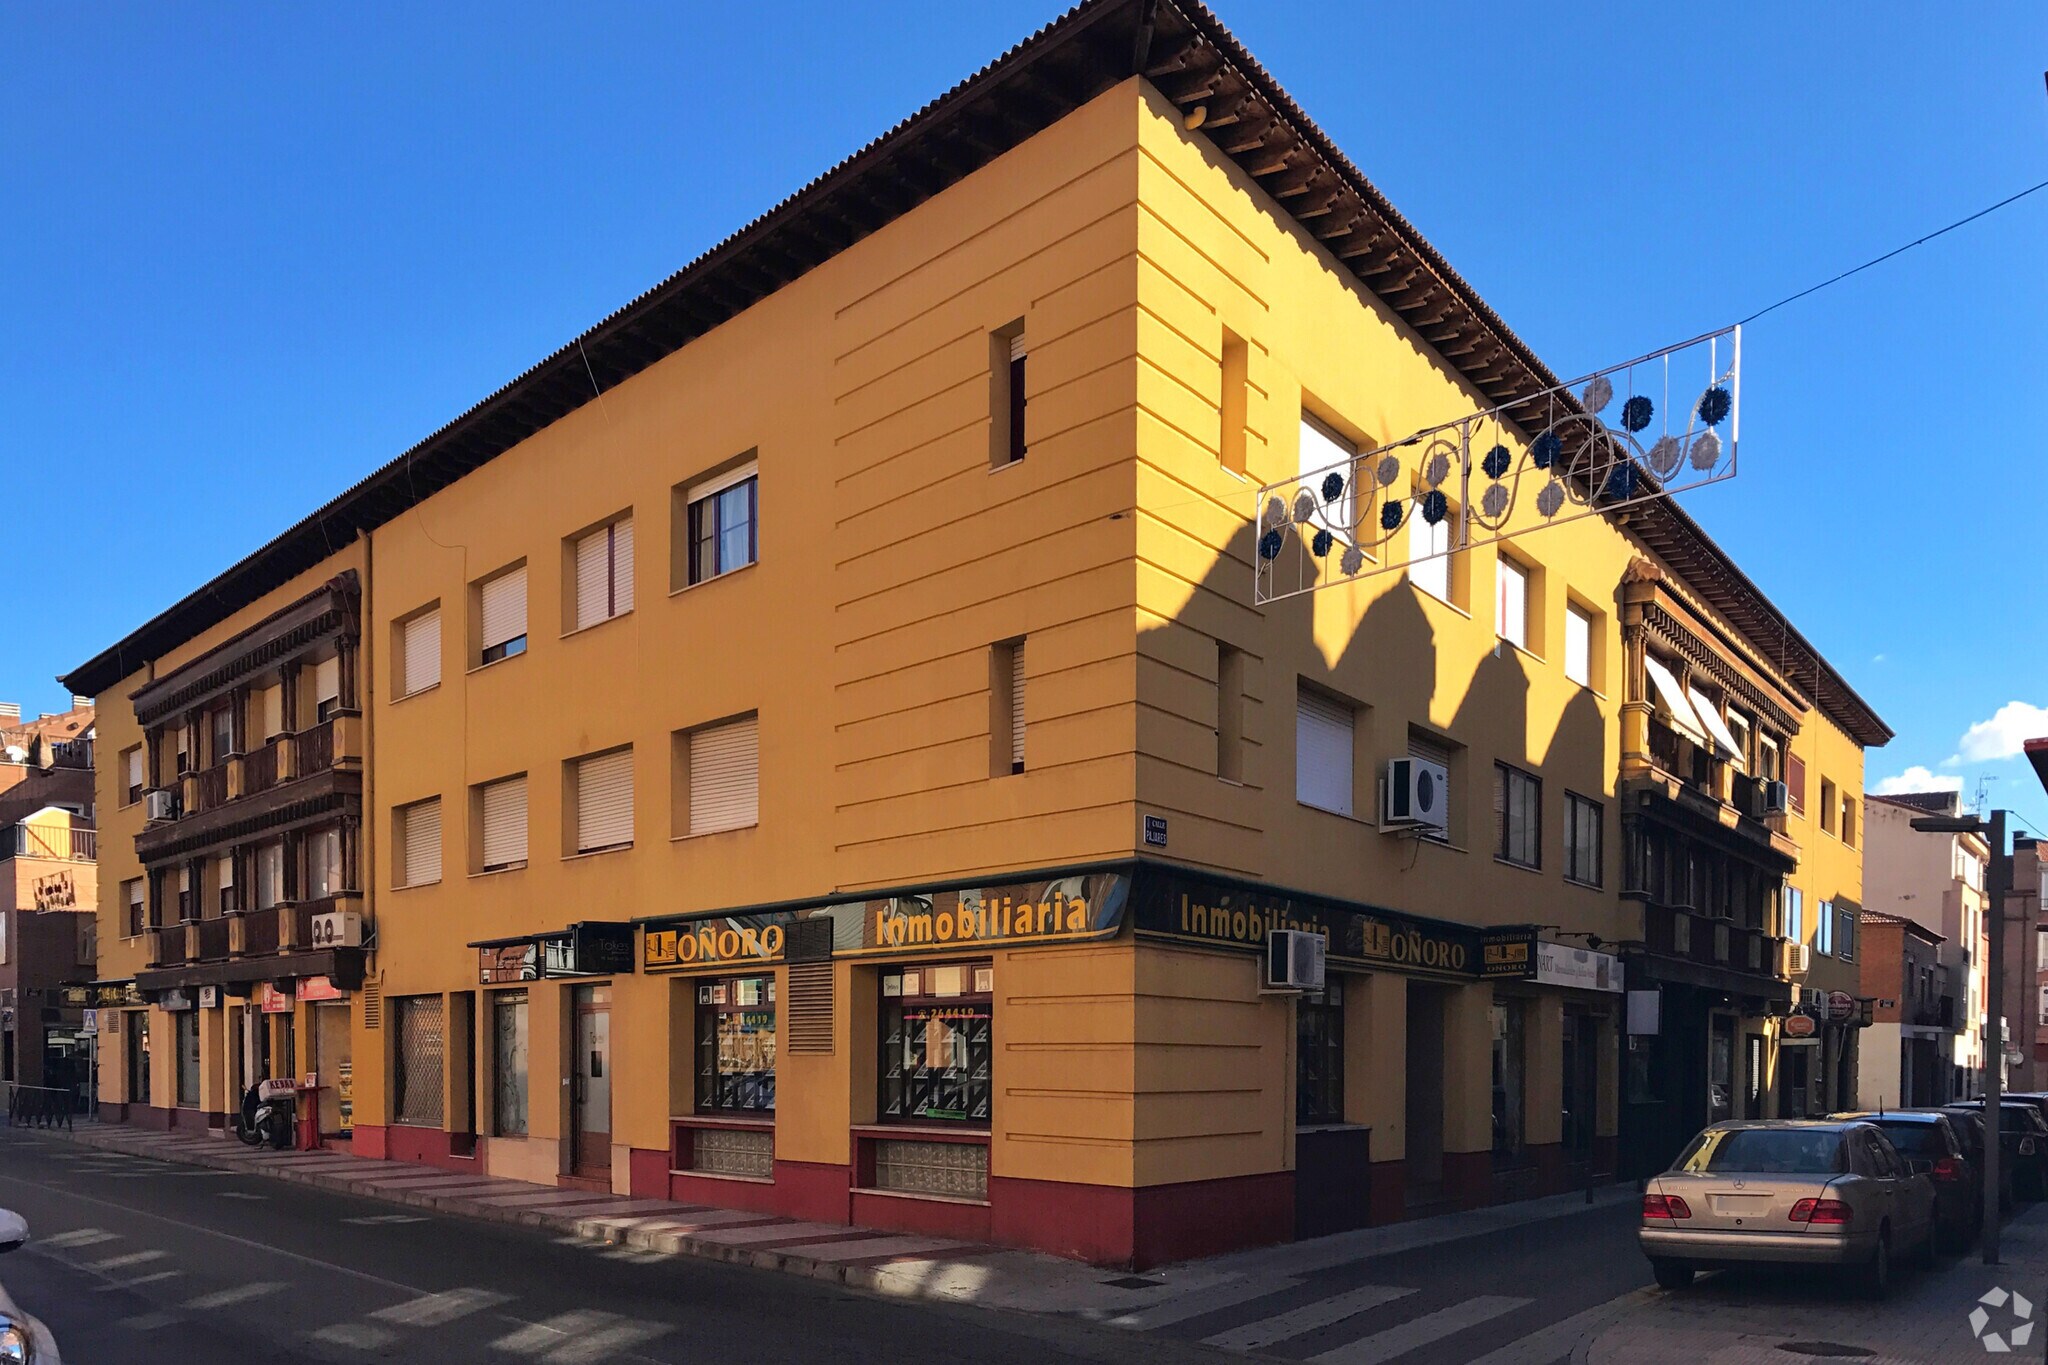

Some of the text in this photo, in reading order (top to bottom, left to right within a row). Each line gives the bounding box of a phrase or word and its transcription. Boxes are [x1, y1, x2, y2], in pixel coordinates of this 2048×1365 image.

[1152, 820, 1165, 829] CALLE
[1146, 830, 1167, 844] PAJARES
[876, 891, 1087, 945] Inmobiliaria
[599, 938, 630, 952] Tokes
[677, 924, 785, 962] OÑORO
[1390, 930, 1466, 970] OÑORO
[930, 1007, 975, 1018] 264419
[269, 1079, 295, 1090] KEBAB
